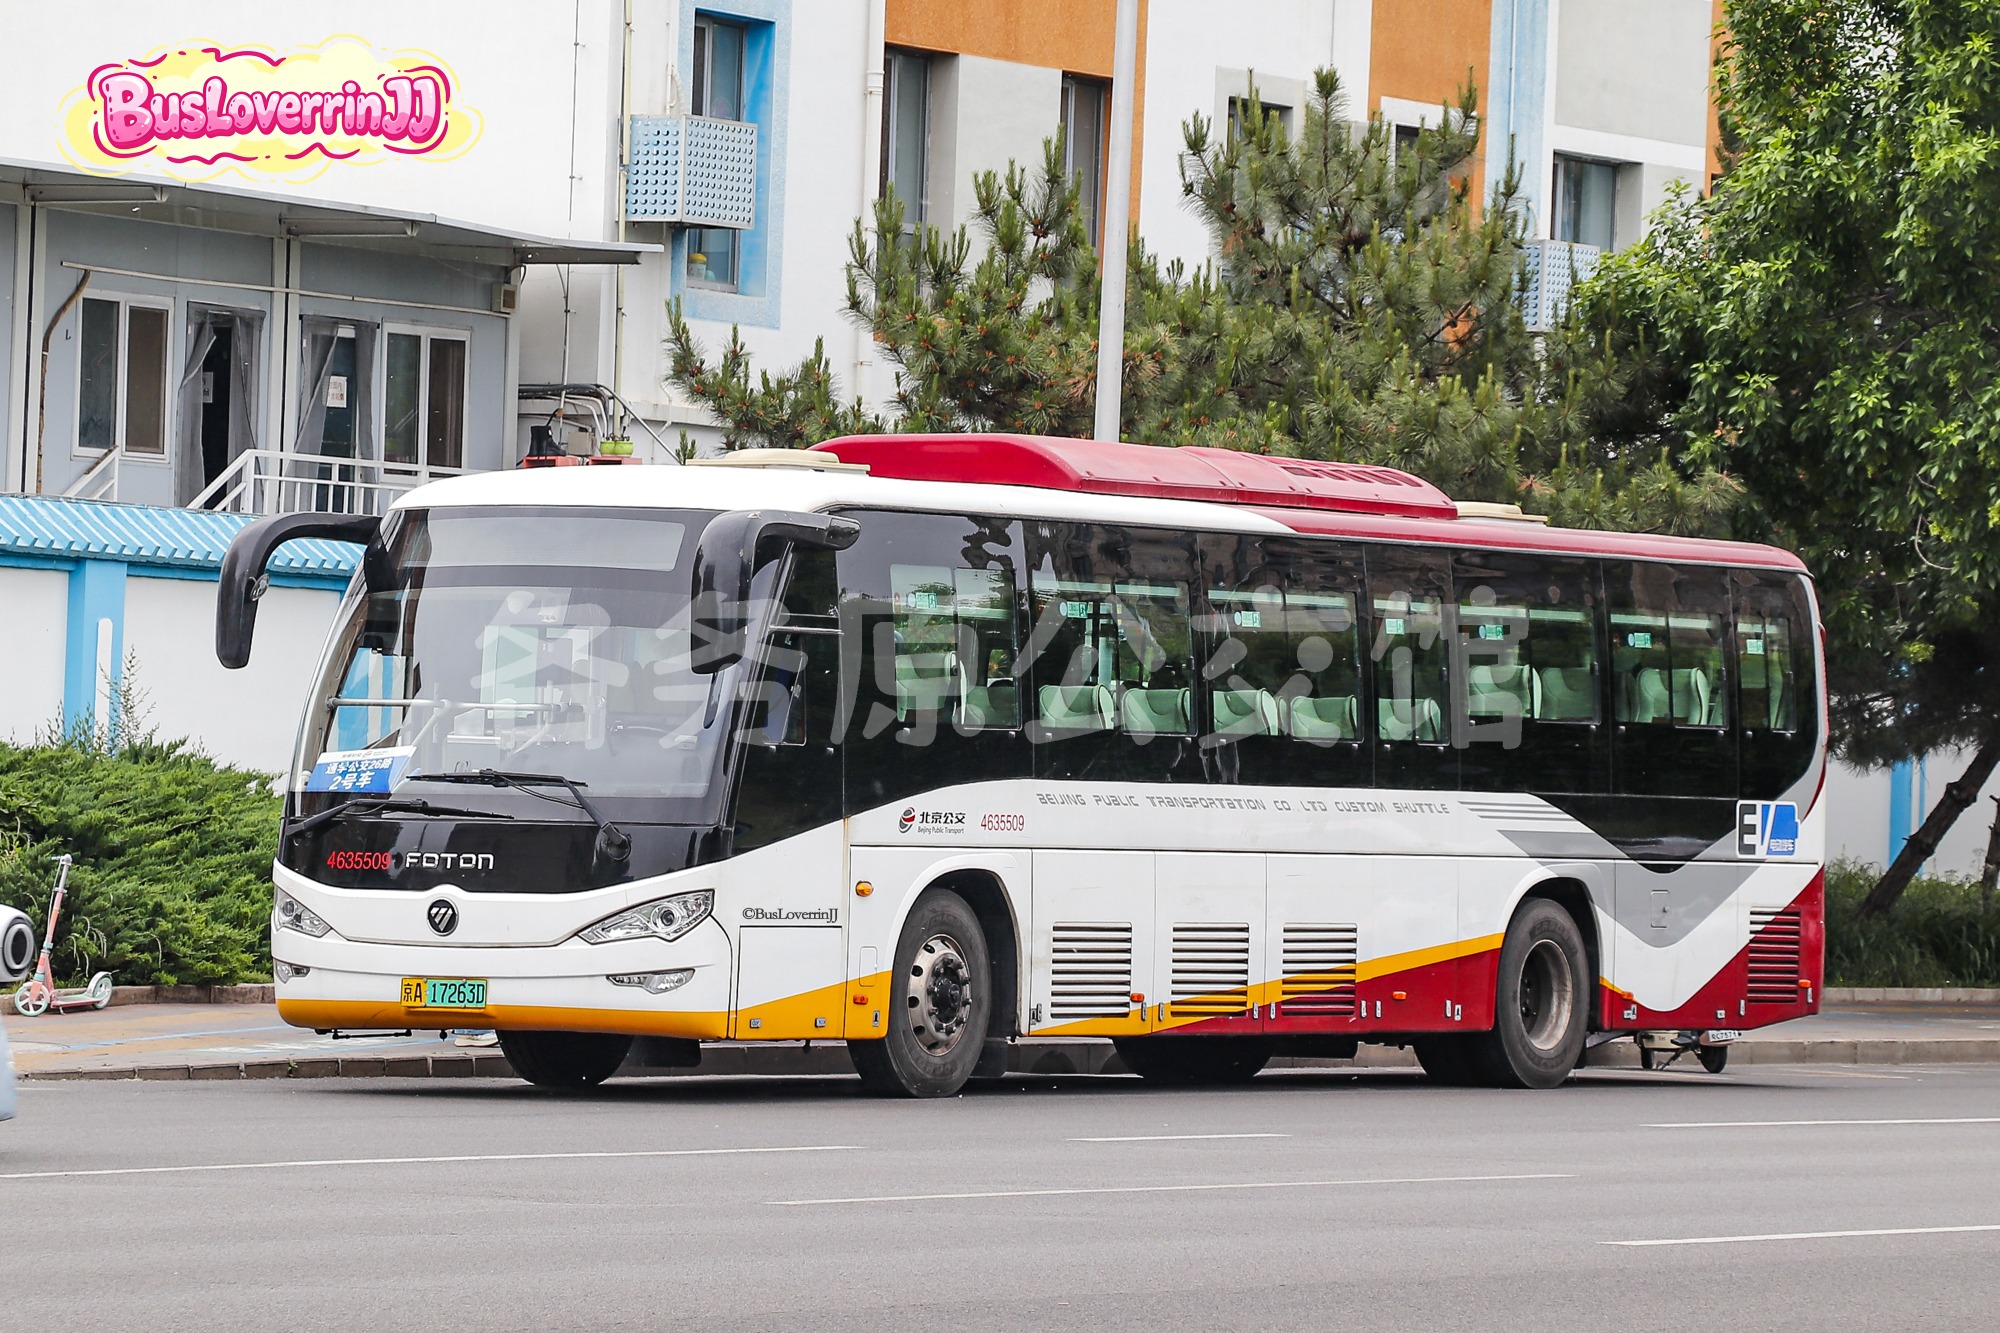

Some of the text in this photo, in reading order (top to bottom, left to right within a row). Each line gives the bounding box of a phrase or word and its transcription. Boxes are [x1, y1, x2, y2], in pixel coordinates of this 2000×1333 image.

[329, 771, 375, 791] 2号车
[1036, 793, 1086, 805] BEIJING
[1093, 795, 1139, 807] PUBLIC
[1146, 795, 1266, 811] TRANSPORTATION
[1334, 801, 1387, 813] CUSTOM
[1392, 802, 1450, 814] SHUTTLE
[919, 811, 966, 824] 北京公交
[981, 814, 1025, 831] 4635509
[918, 826, 964, 836] Beijing Public Transport
[327, 851, 391, 870] 4635509
[405, 852, 494, 870] FOTON
[431, 983, 485, 1003] 17263D
